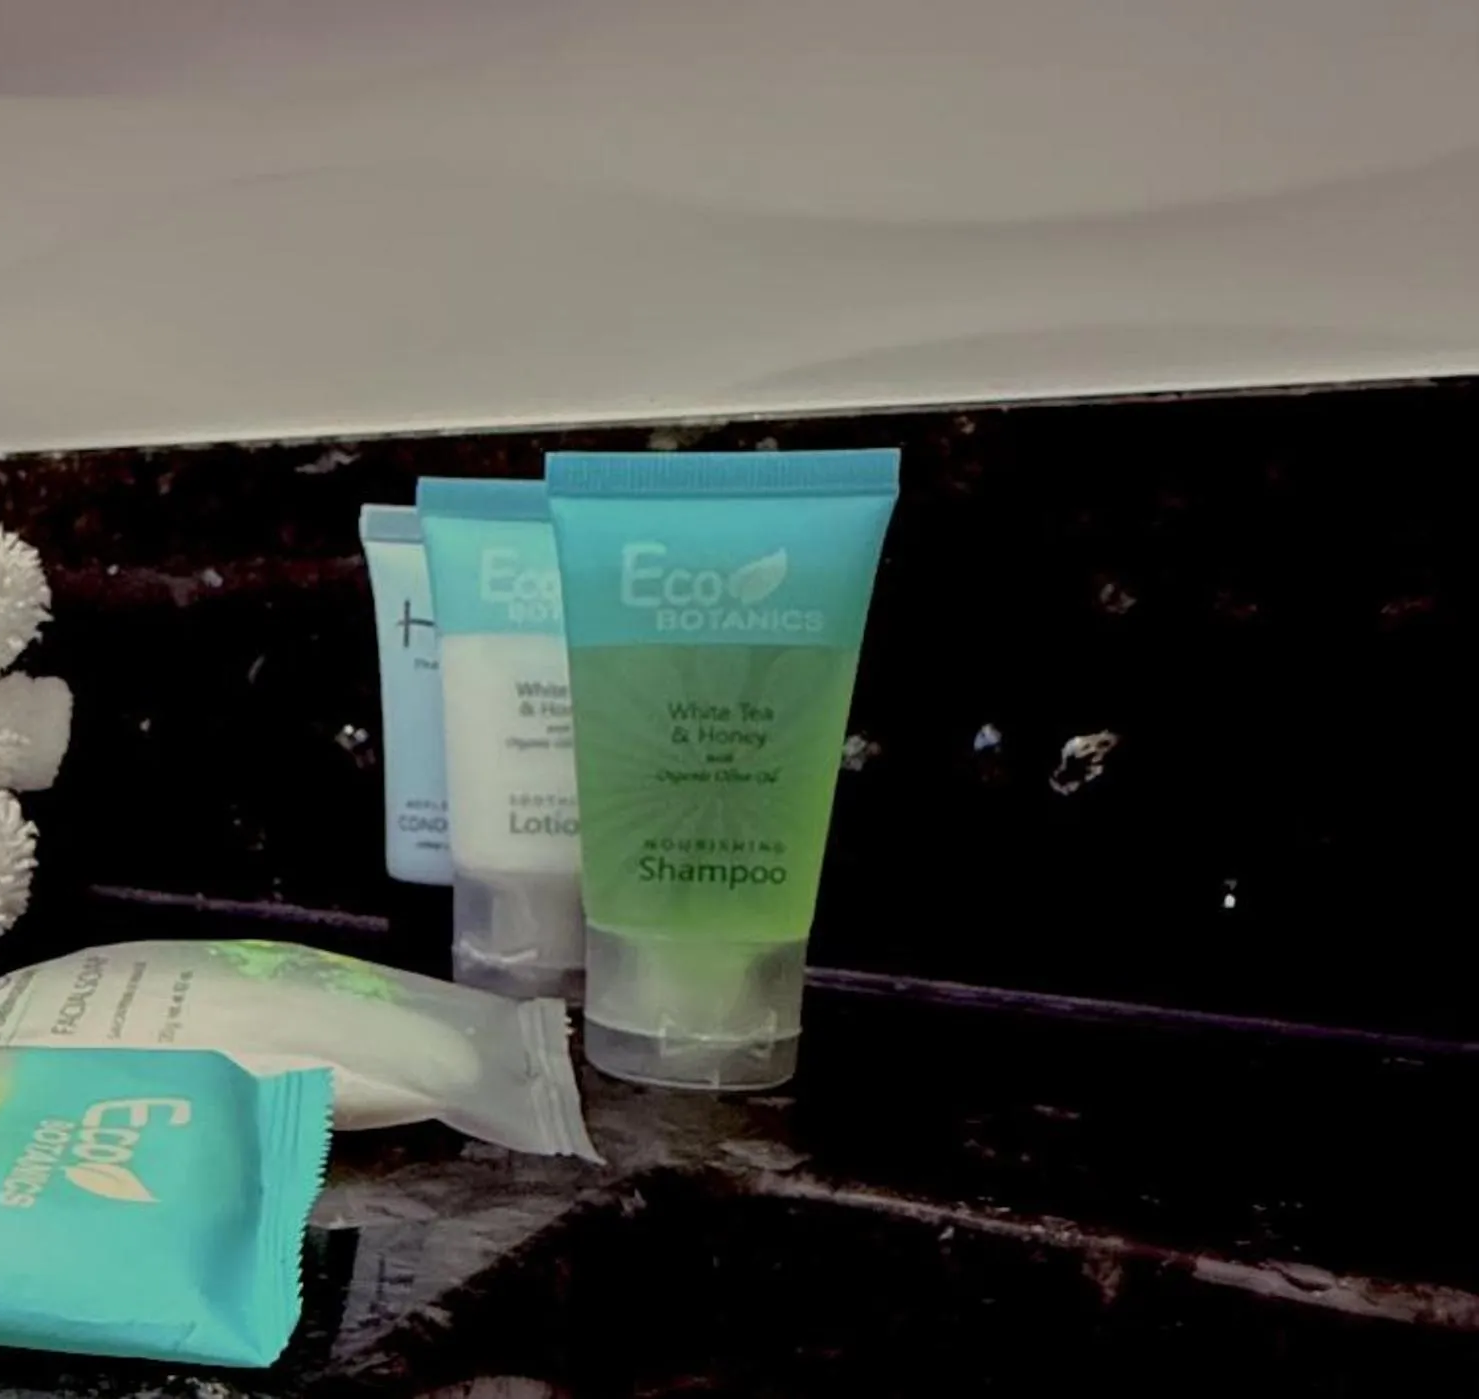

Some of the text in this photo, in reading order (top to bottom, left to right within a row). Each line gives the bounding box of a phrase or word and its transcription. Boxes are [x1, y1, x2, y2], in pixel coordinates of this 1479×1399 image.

[622, 542, 722, 608] Eco
[656, 608, 825, 632] BOTANICS
[519, 700, 535, 717] &
[668, 702, 775, 722] White Tea
[671, 726, 766, 749] & Honey
[509, 811, 581, 837] Lotio
[639, 856, 787, 891] Shampoo
[72, 1097, 192, 1164] Eco
